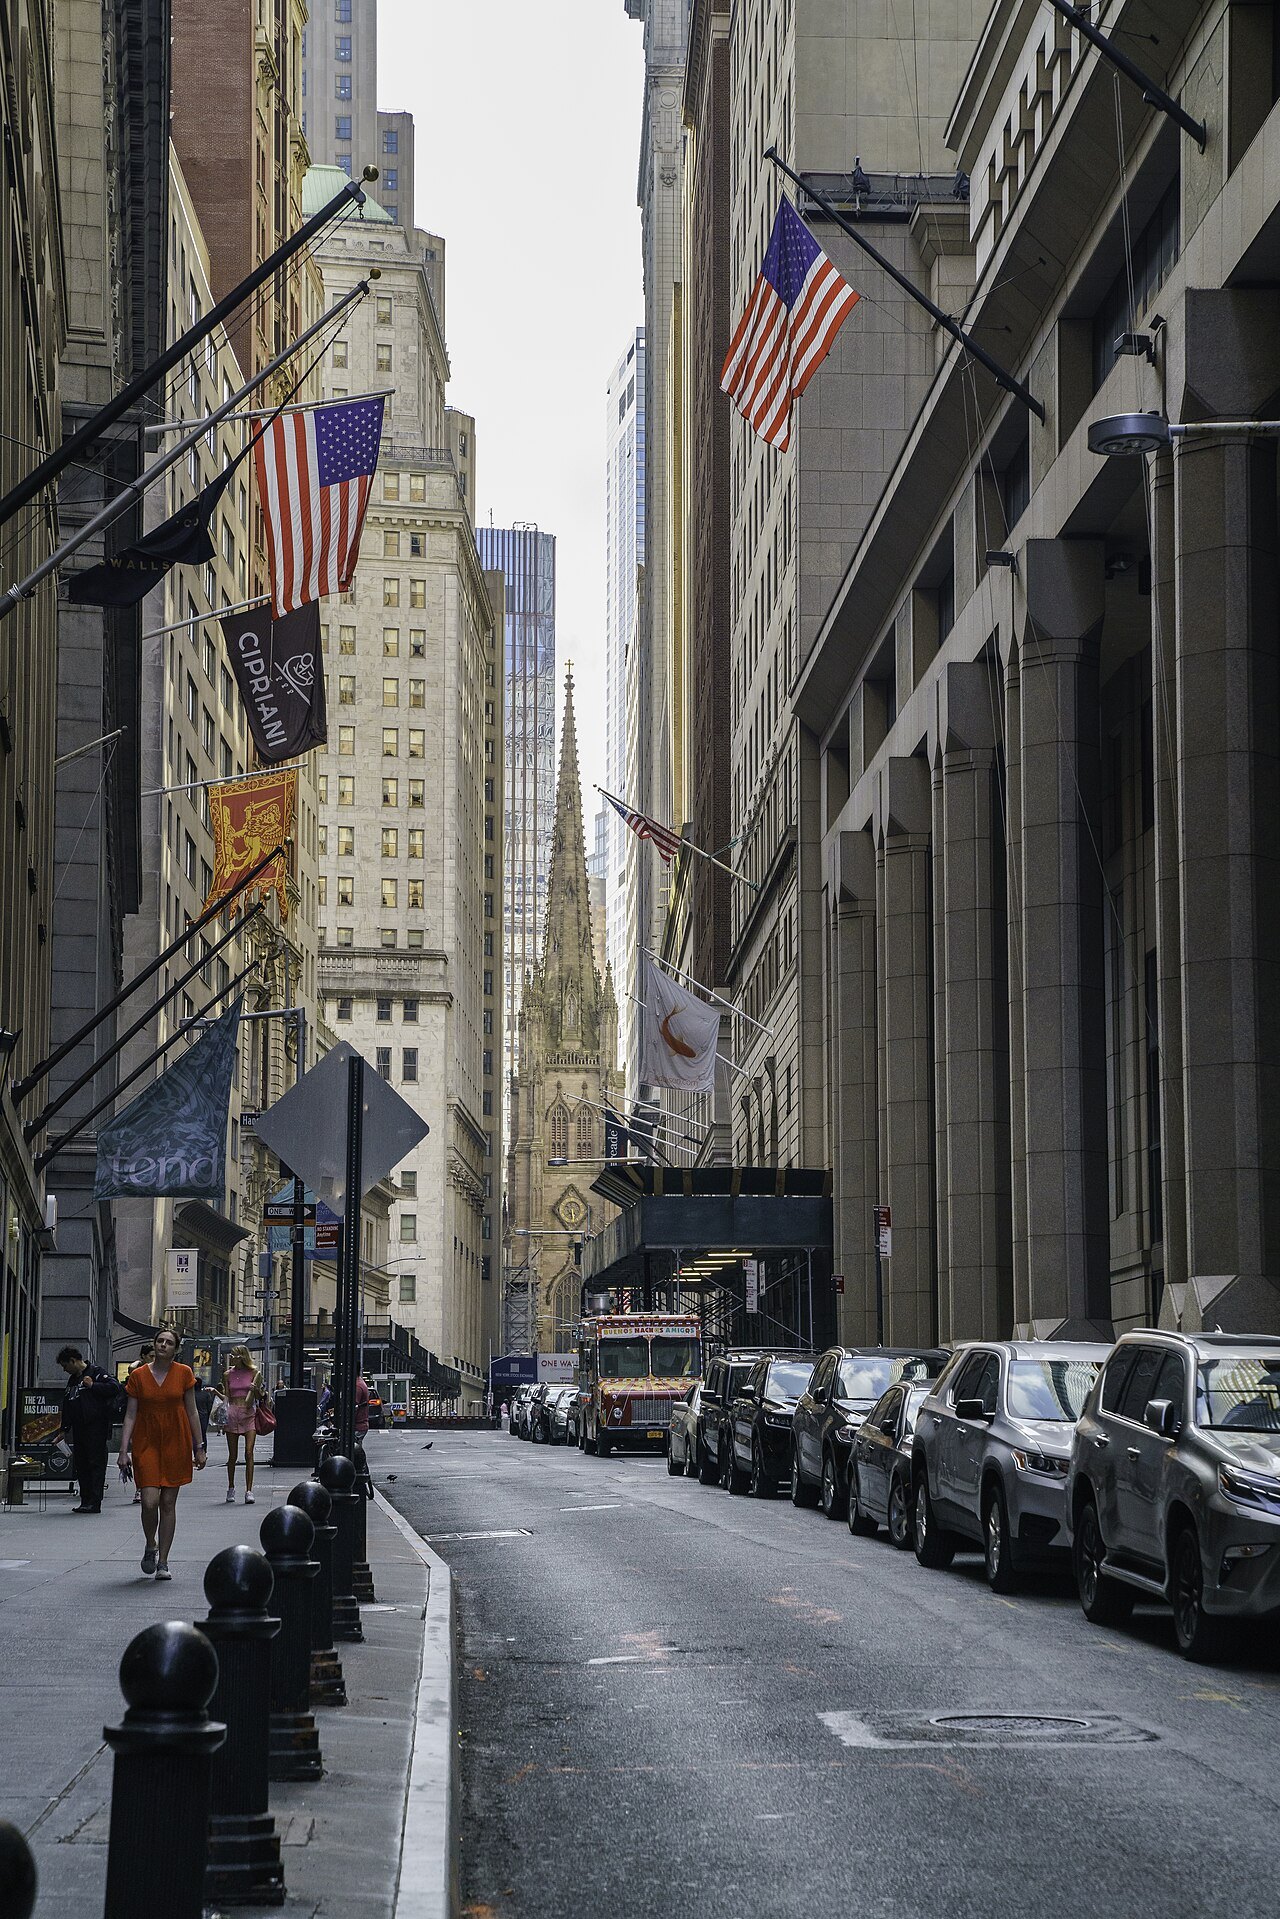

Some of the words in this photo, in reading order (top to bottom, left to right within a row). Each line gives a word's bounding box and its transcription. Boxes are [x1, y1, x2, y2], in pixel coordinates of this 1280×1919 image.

[238, 632, 288, 748] CIPRIANI
[105, 1146, 218, 1189] tend
[603, 1327, 633, 1335] BUENOS
[25, 1396, 36, 1404] THE
[24, 1405, 36, 1414] HAS
[36, 1405, 59, 1414] LANDED
